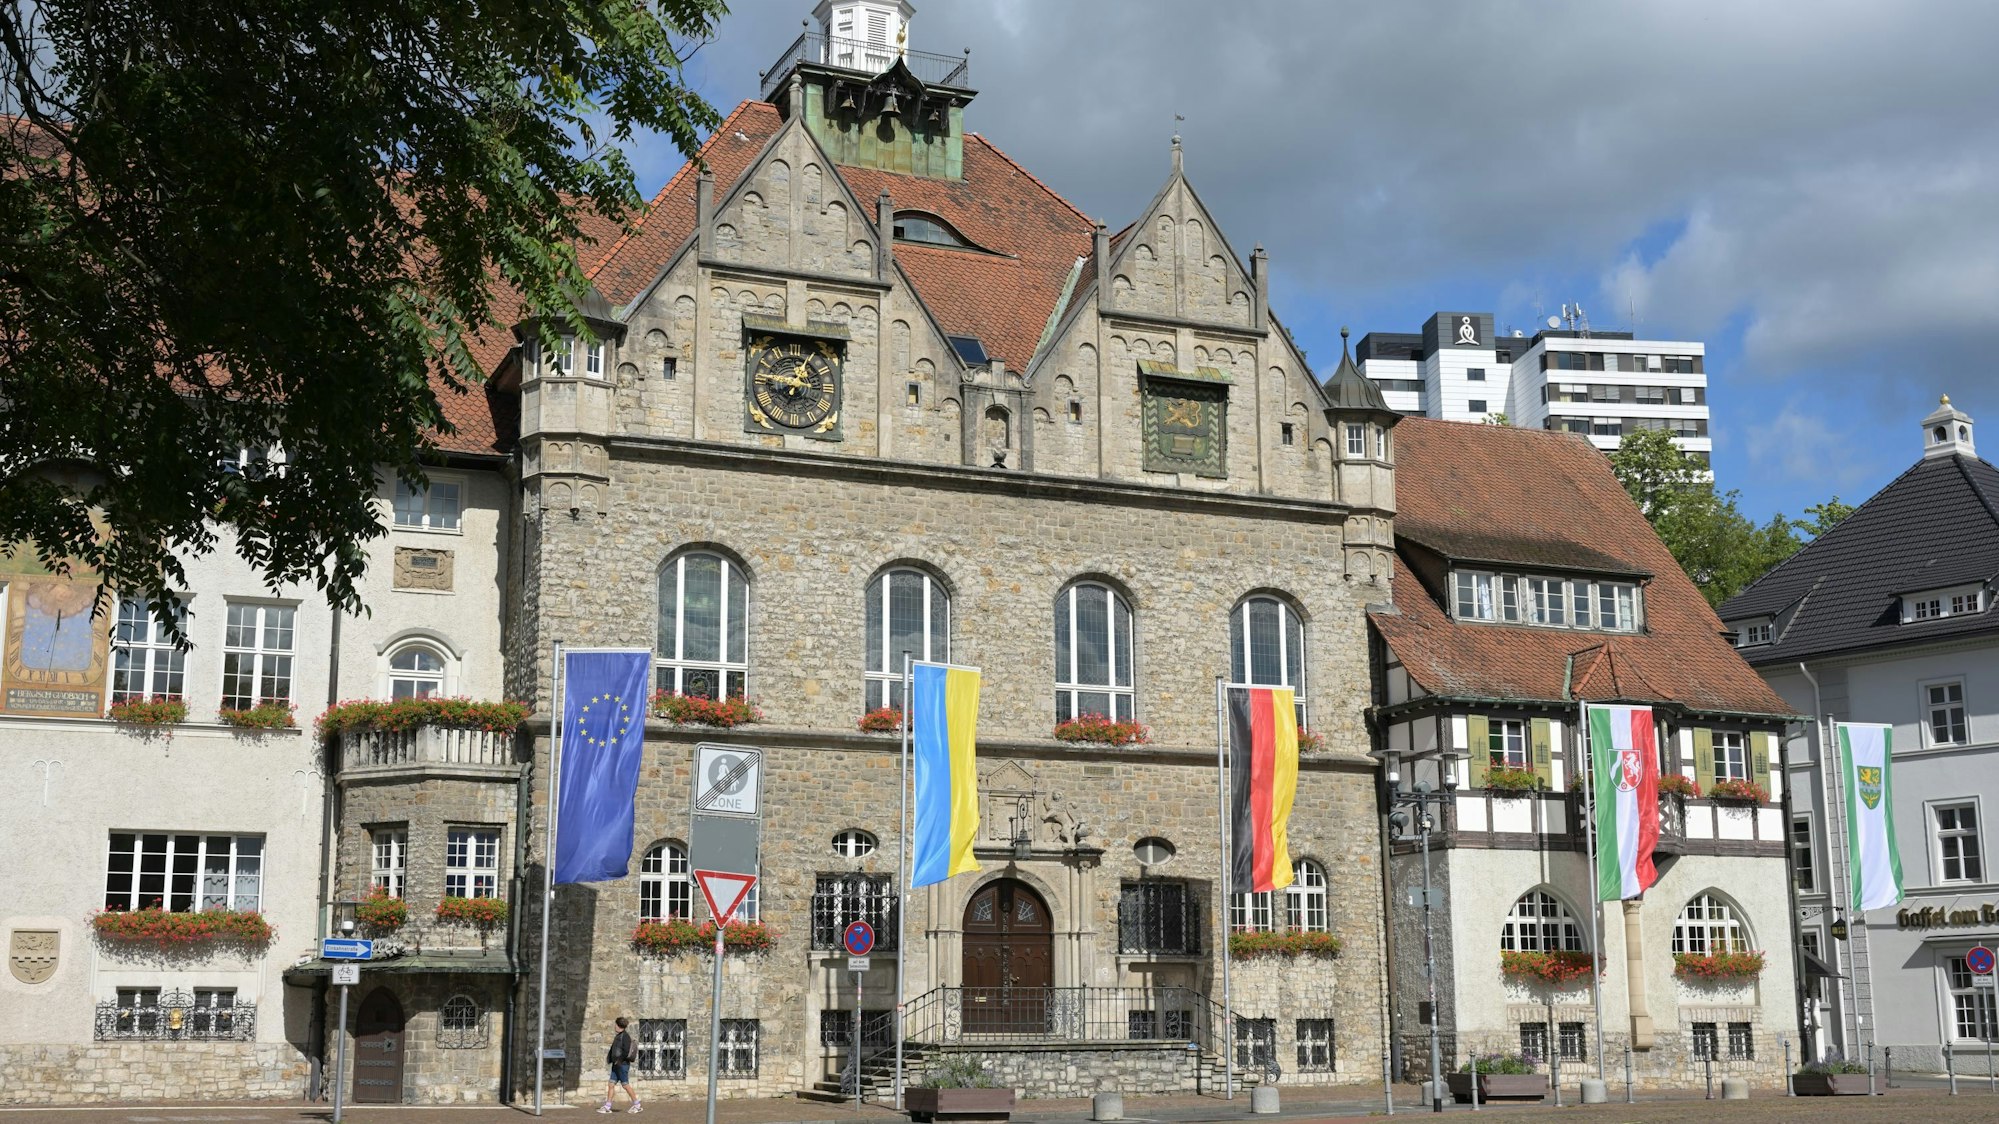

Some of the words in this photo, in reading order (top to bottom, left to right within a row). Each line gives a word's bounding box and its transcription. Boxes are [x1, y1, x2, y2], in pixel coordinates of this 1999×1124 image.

[822, 383, 834, 393] III
[17, 690, 51, 699] BERGISCH
[52, 691, 89, 700] GLADBACH
[711, 798, 742, 809] ZONE
[1897, 906, 1948, 928] Gaffel
[1949, 910, 1981, 926] am
[1981, 904, 1999, 924] B
